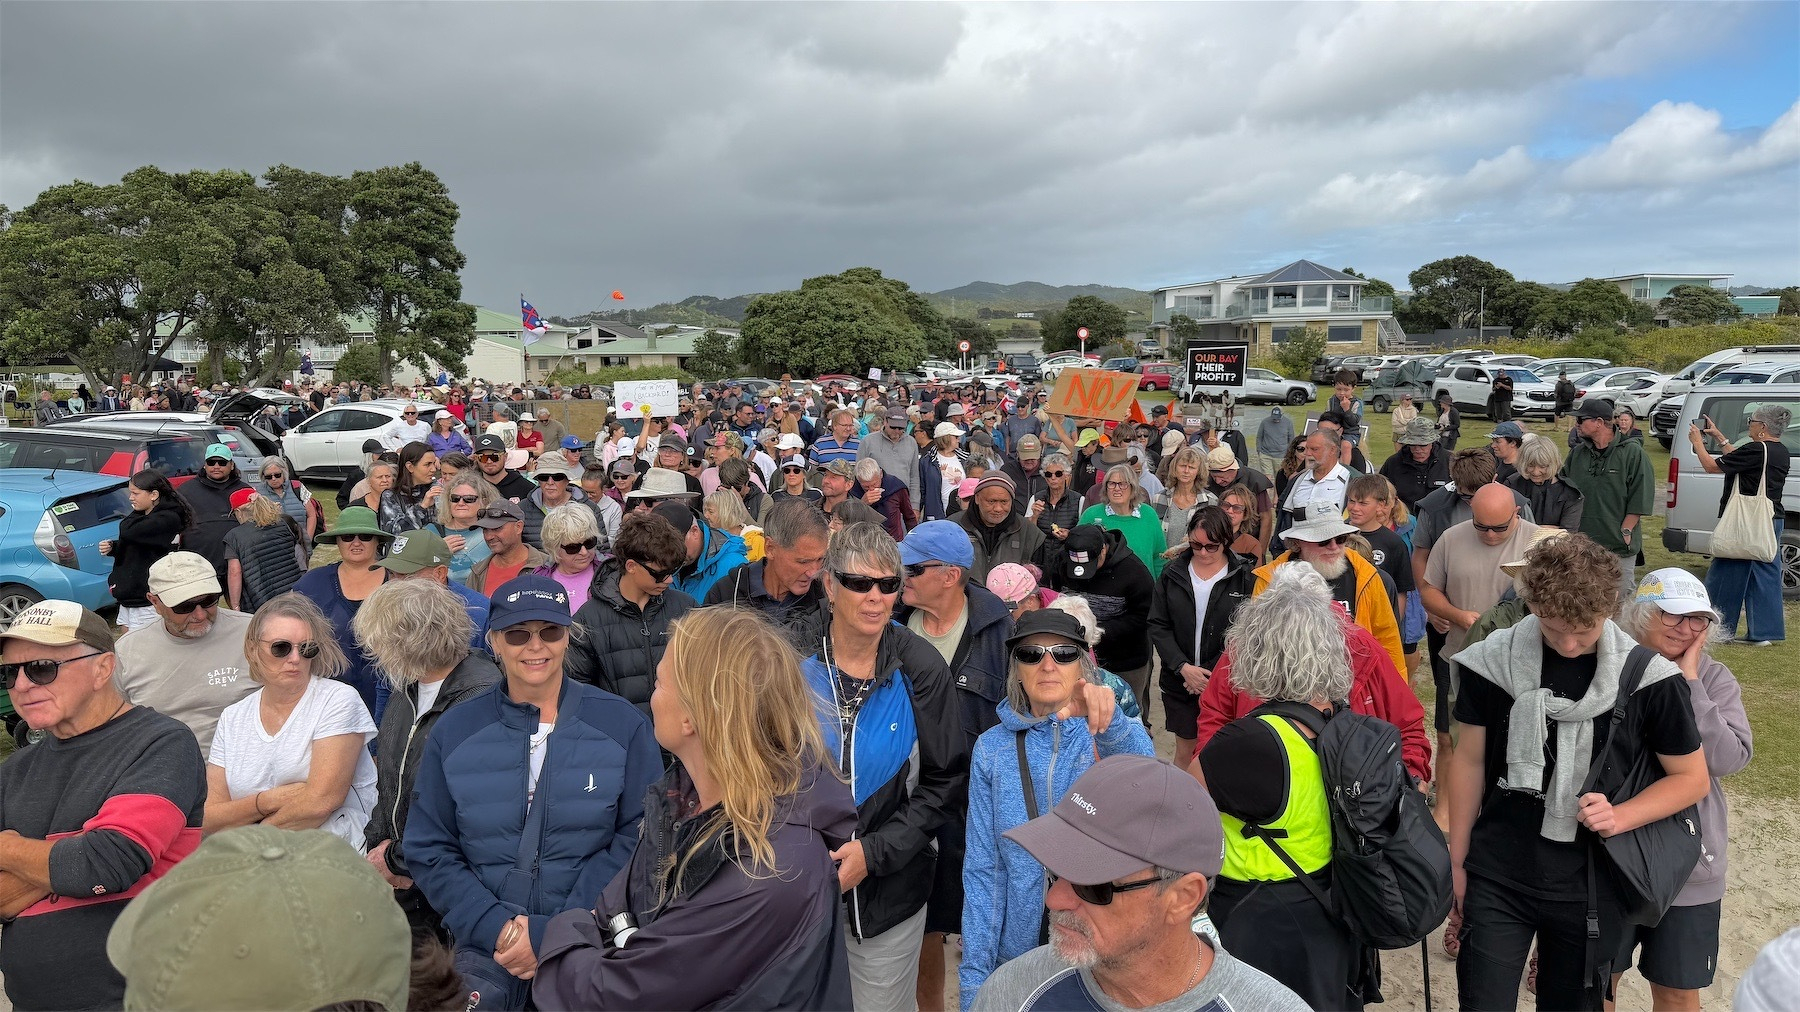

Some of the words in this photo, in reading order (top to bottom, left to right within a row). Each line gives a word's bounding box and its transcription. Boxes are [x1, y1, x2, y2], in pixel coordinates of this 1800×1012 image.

[1195, 353, 1217, 363] OUR
[1219, 354, 1238, 363] BAY
[1196, 363, 1225, 372] THEIR
[1194, 372, 1236, 382] PROFIT?
[1063, 374, 1135, 411] NO!
[26, 616, 52, 626] HALL
[207, 667, 239, 679] SALTY
[208, 675, 238, 685] CREW
[1070, 792, 1097, 816] Thirsty.
